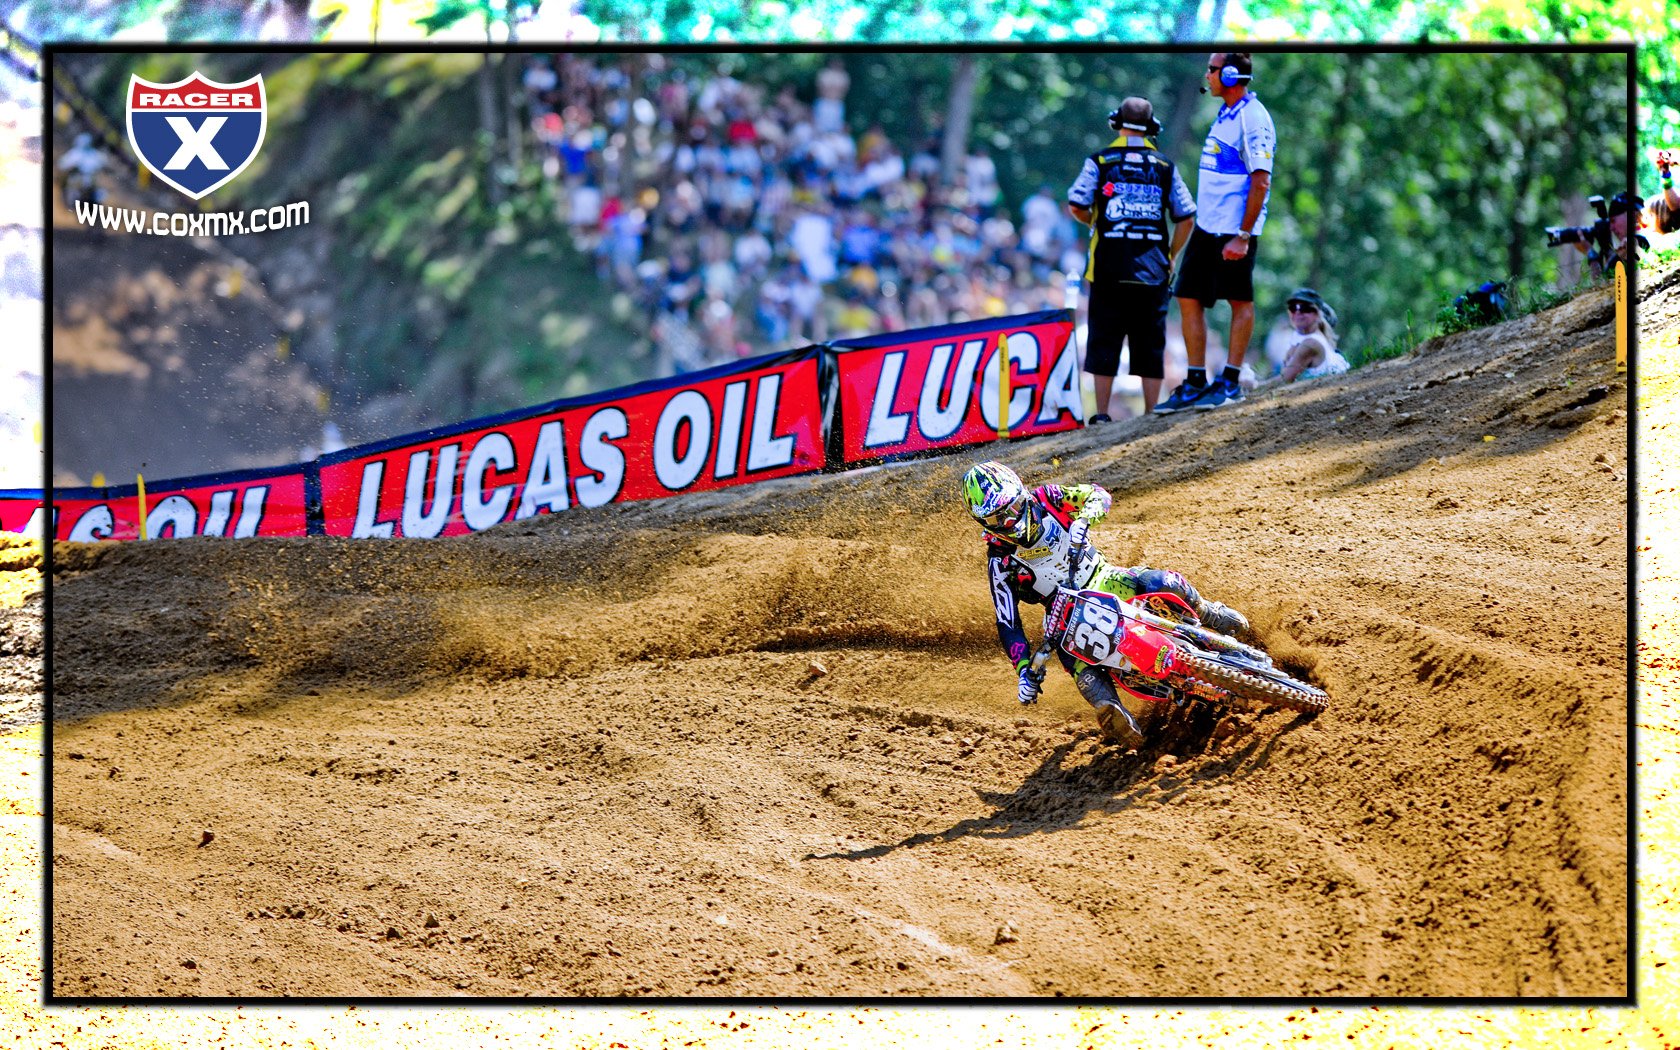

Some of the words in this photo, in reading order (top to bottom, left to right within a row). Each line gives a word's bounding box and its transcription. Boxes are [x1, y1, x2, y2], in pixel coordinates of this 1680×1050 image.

[352, 405, 629, 539] LUCAS
[652, 371, 797, 491] OIL
[1074, 596, 1119, 661] 38
